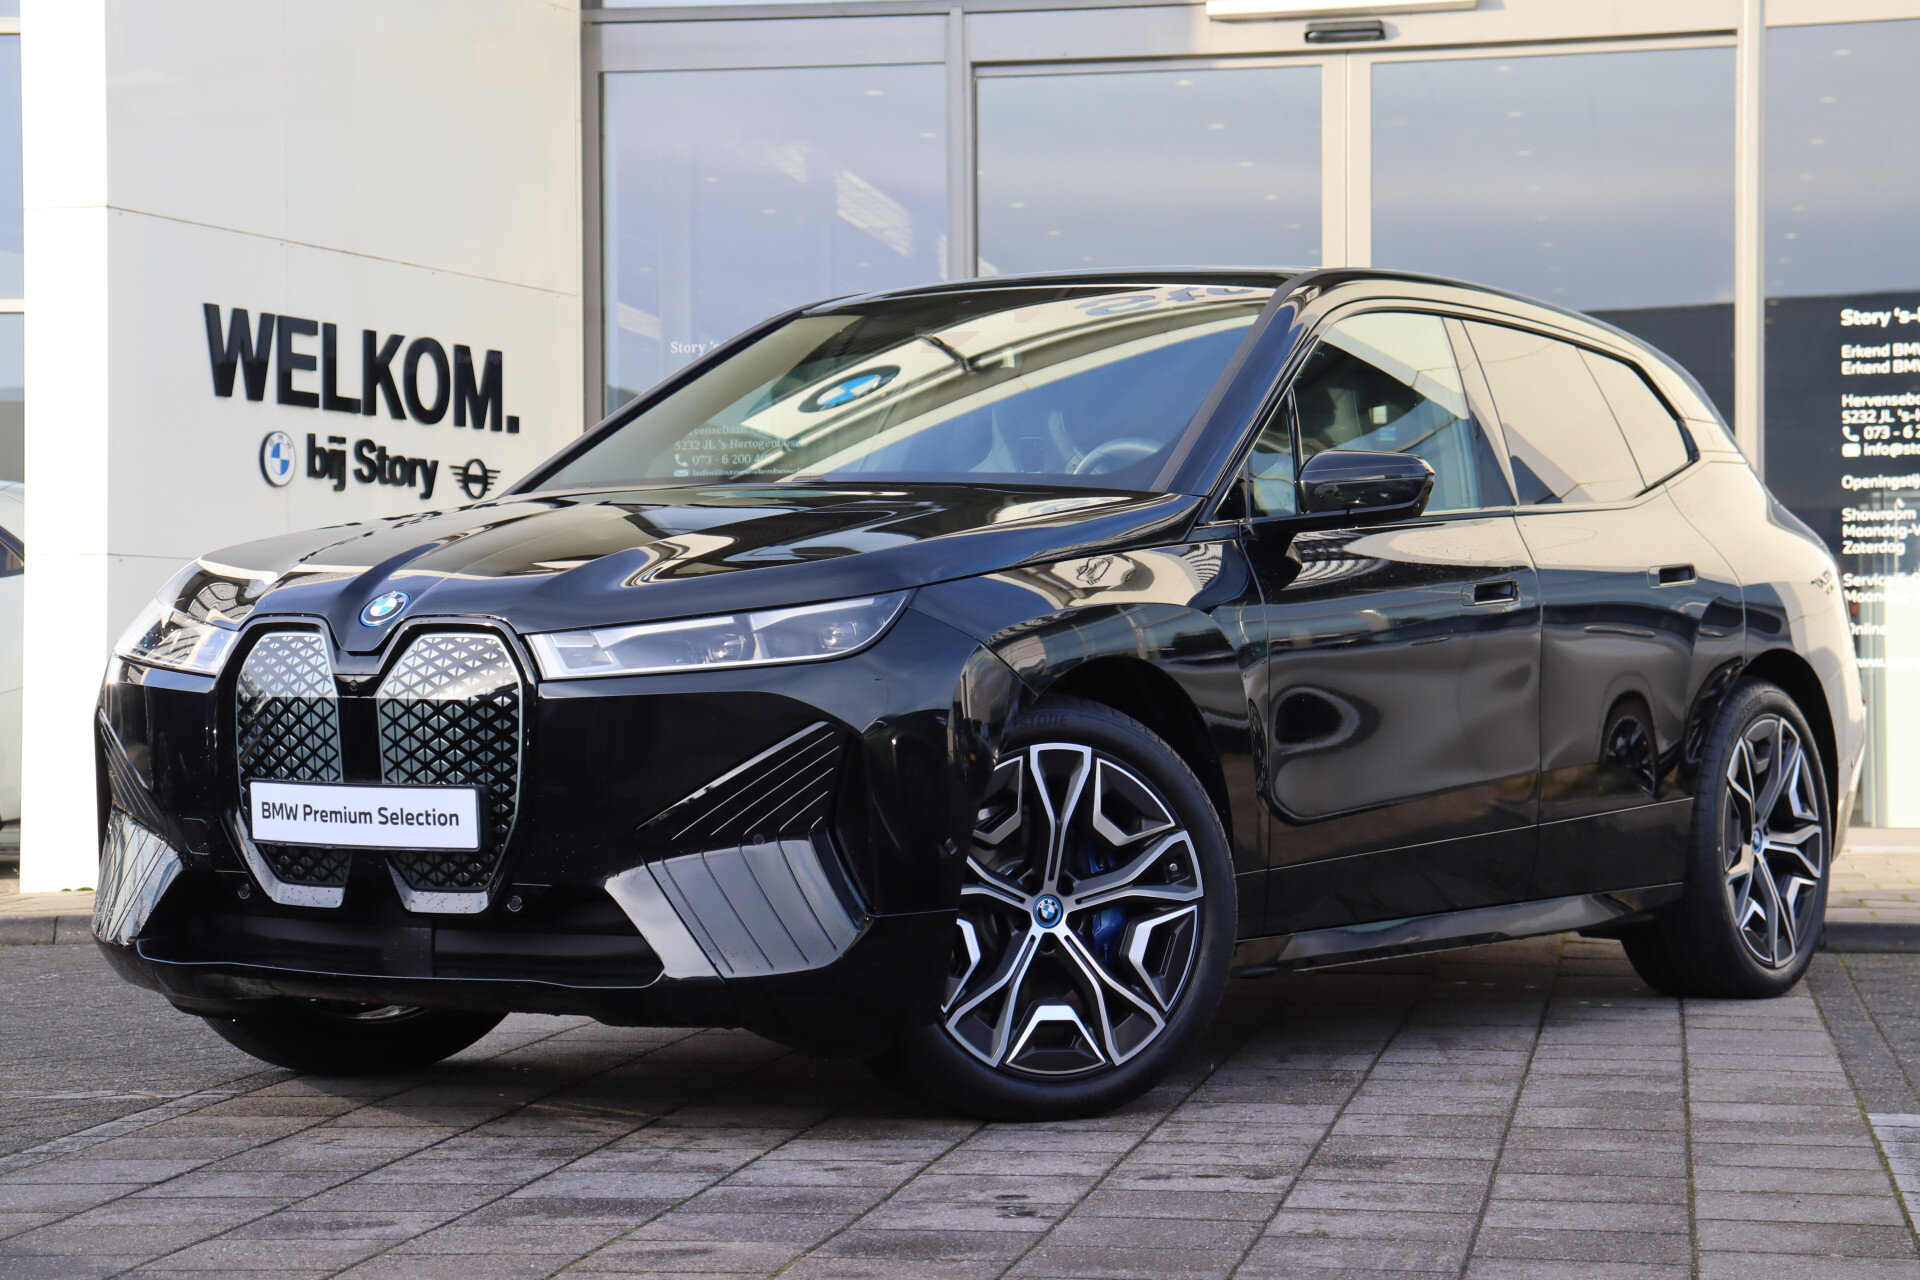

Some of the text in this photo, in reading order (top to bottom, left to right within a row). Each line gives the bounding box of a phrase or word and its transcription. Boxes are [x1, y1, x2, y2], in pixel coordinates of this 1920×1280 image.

[1840, 308, 1891, 328] Story
[670, 341, 705, 357] Story
[1841, 343, 1890, 359] Erkend
[203, 302, 520, 434] WELKOM.
[1841, 359, 1890, 375] Erkend
[1841, 409, 1877, 424] 5232
[1878, 409, 1895, 424] JL
[1863, 425, 1891, 440] 073
[1902, 424, 1914, 439] 6
[732, 453, 751, 464] 200
[353, 437, 439, 500] Story
[1841, 474, 1920, 491] Openingstij
[1841, 507, 1917, 522] Showroom
[1842, 540, 1905, 555] Zaterdag
[261, 801, 460, 826] BMW Premium Selection
